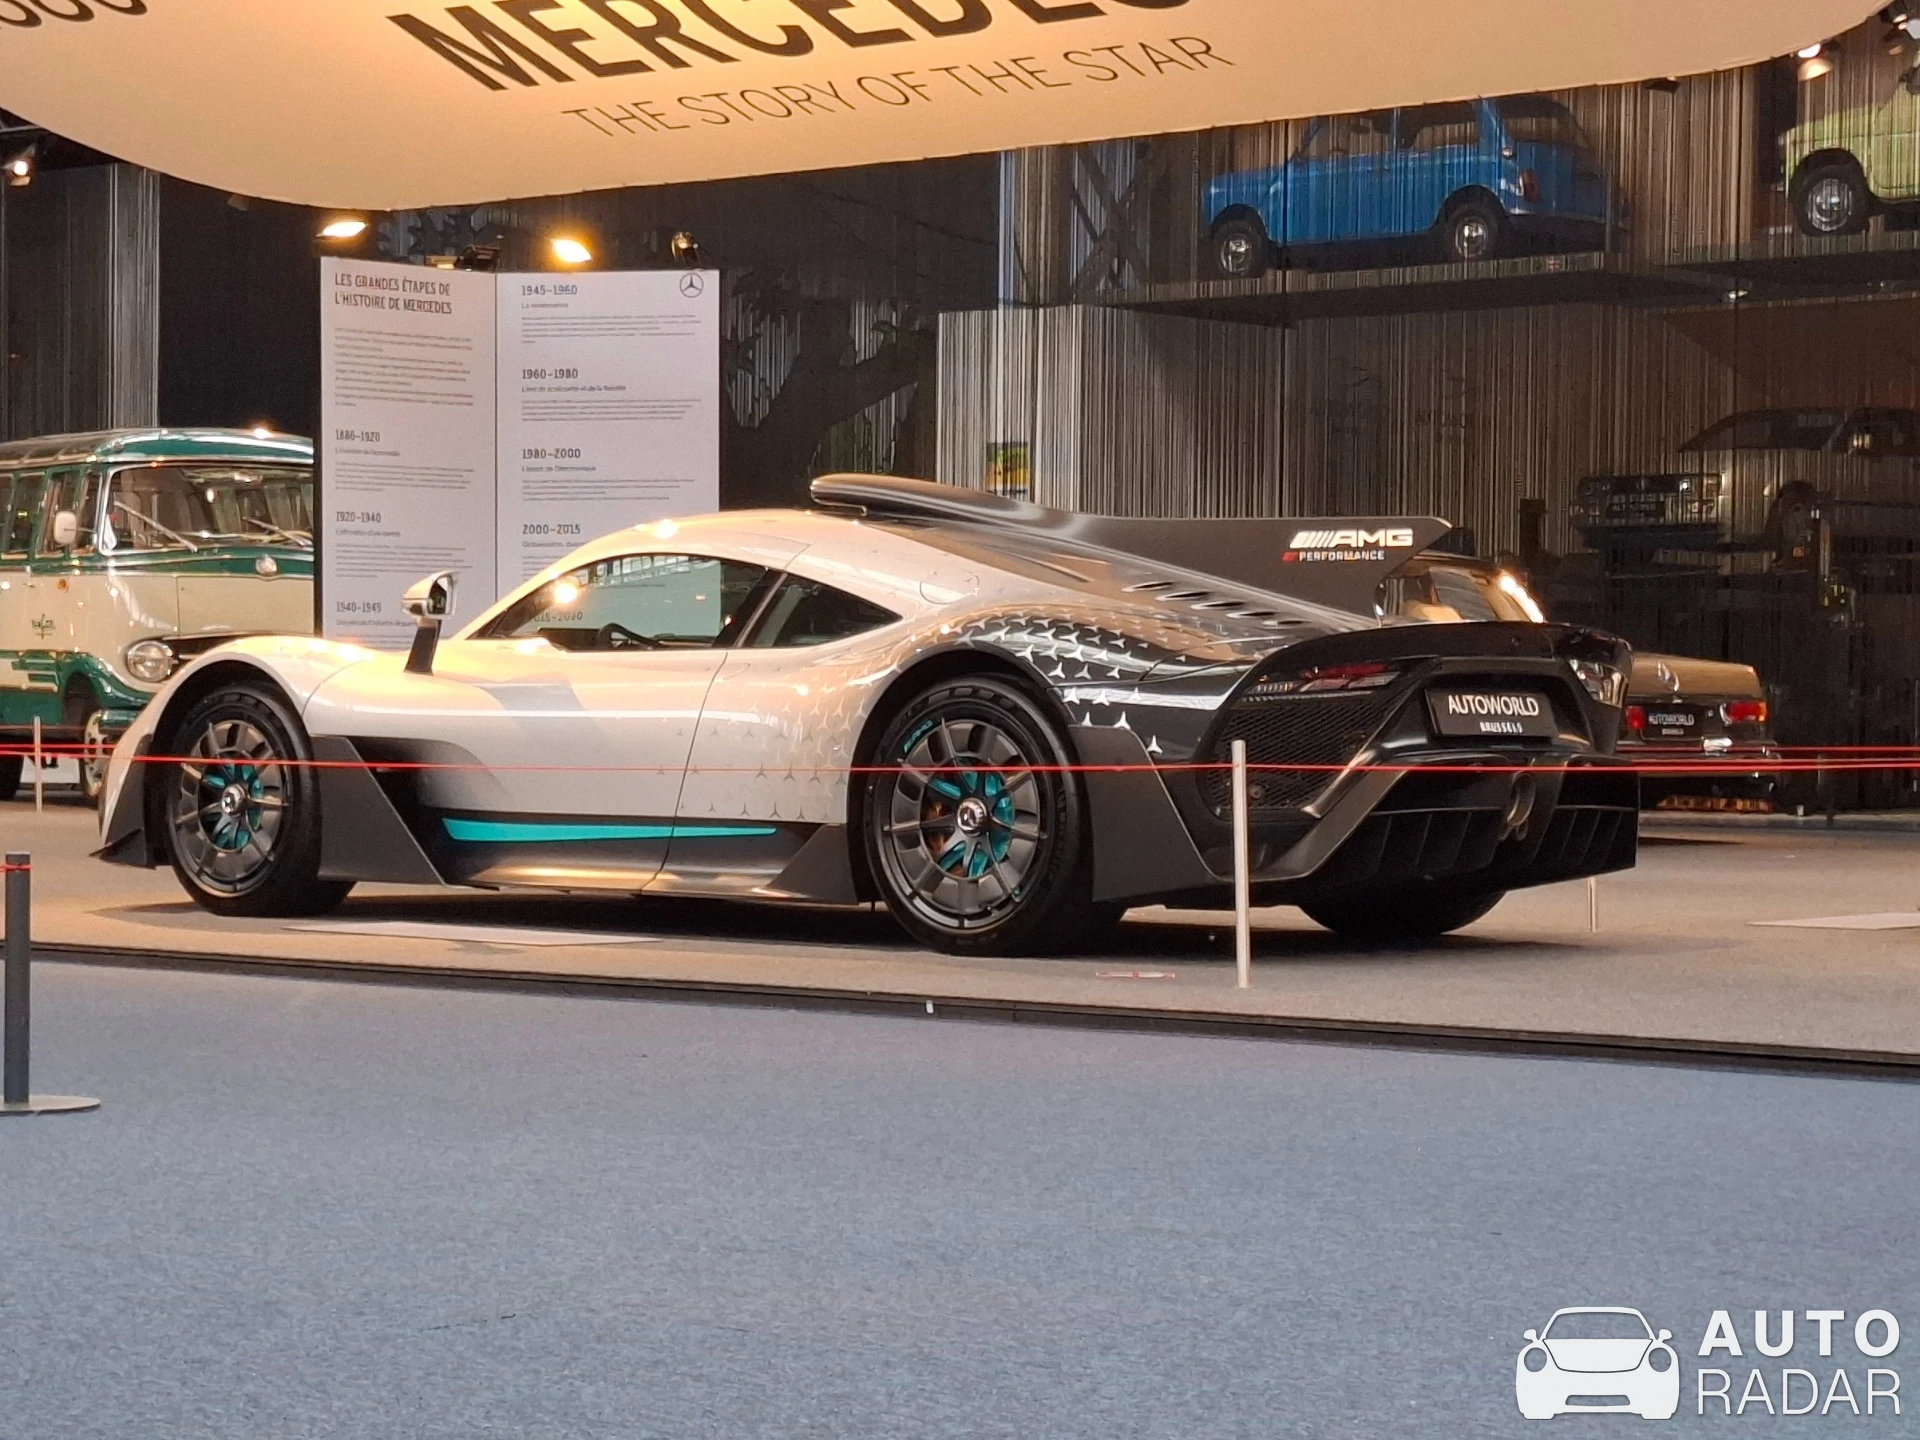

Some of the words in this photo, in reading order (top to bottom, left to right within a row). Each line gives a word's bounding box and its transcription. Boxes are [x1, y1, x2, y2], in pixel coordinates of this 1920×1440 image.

[386, 0, 1191, 91] MERCE
[563, 101, 690, 138] THE
[676, 80, 857, 126] STORY
[856, 71, 933, 107] OF
[929, 56, 1072, 96] THE
[1062, 36, 1236, 82] STAR
[335, 273, 352, 287] LES
[355, 275, 400, 291] GRANDES
[402, 276, 436, 295] ÉTAPES
[439, 283, 450, 296] DE
[335, 292, 385, 309] L'HISTOIRE
[388, 298, 400, 311] DE
[403, 300, 452, 314] MERCEDES
[522, 368, 578, 380] 1960-1980
[522, 448, 581, 460] 1980-2000
[336, 511, 382, 524] 1920-1940
[522, 524, 581, 535] 2000-2015
[1299, 550, 1385, 562] PERFORMANCE
[1448, 694, 1539, 716] AUTOWORLD
